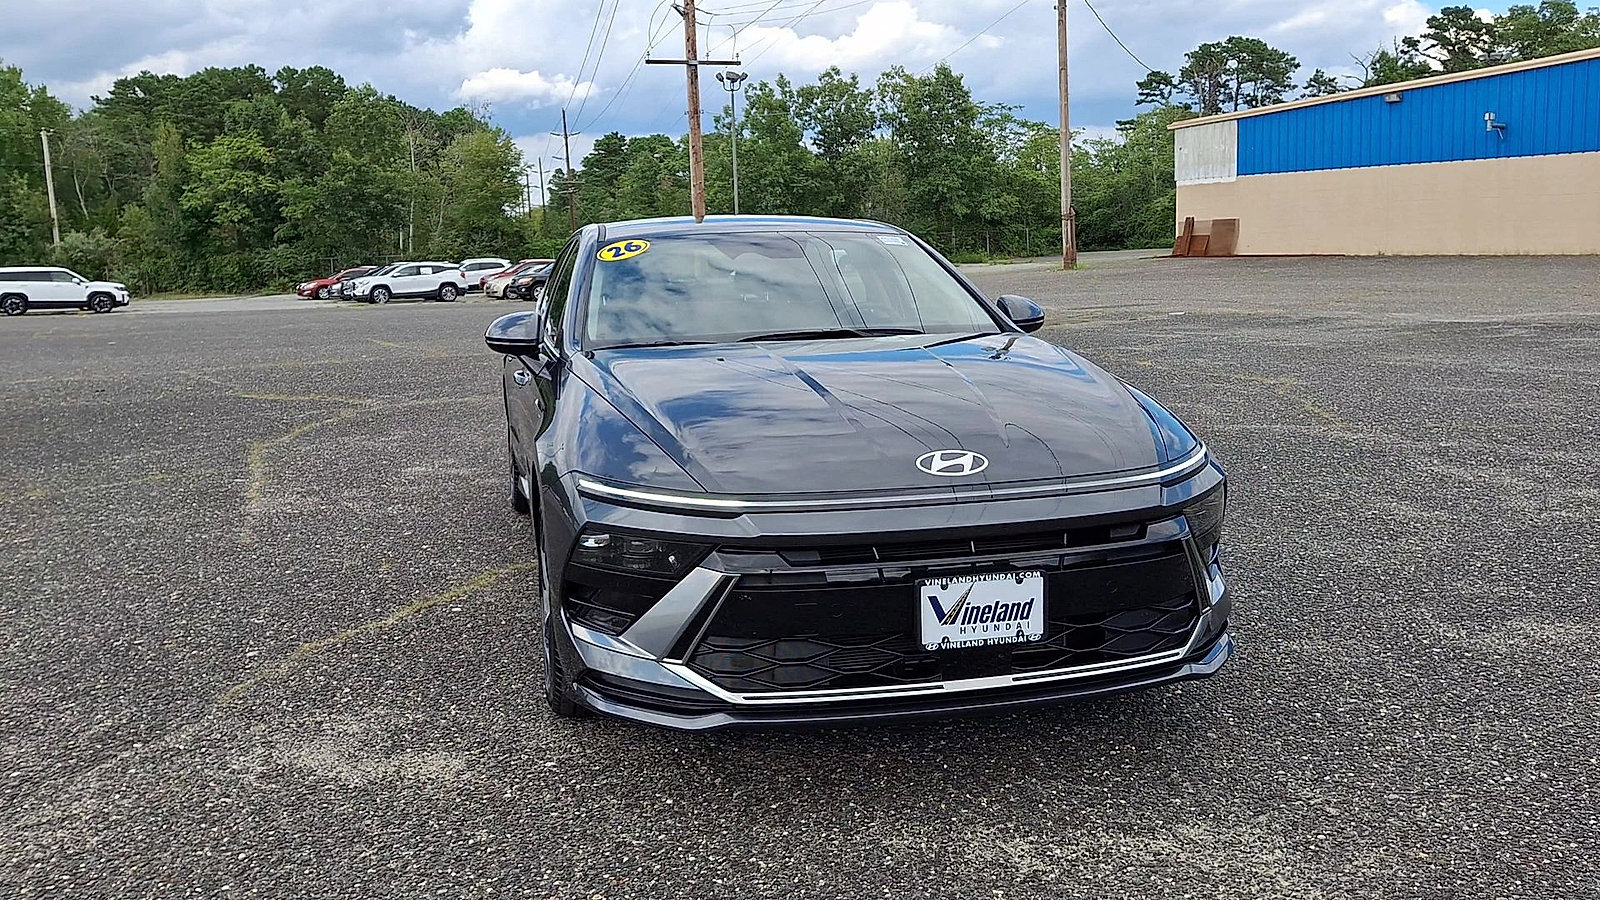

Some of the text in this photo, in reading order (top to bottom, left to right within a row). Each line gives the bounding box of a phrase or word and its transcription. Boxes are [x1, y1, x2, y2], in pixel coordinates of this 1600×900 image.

[606, 241, 642, 258] 26
[924, 571, 1041, 586] VINELANDHYUNDAI.COM
[927, 581, 1036, 626] Vineland
[960, 621, 1030, 635] HYUNDAI
[940, 635, 1027, 650] VINELAND HYUNDAI
